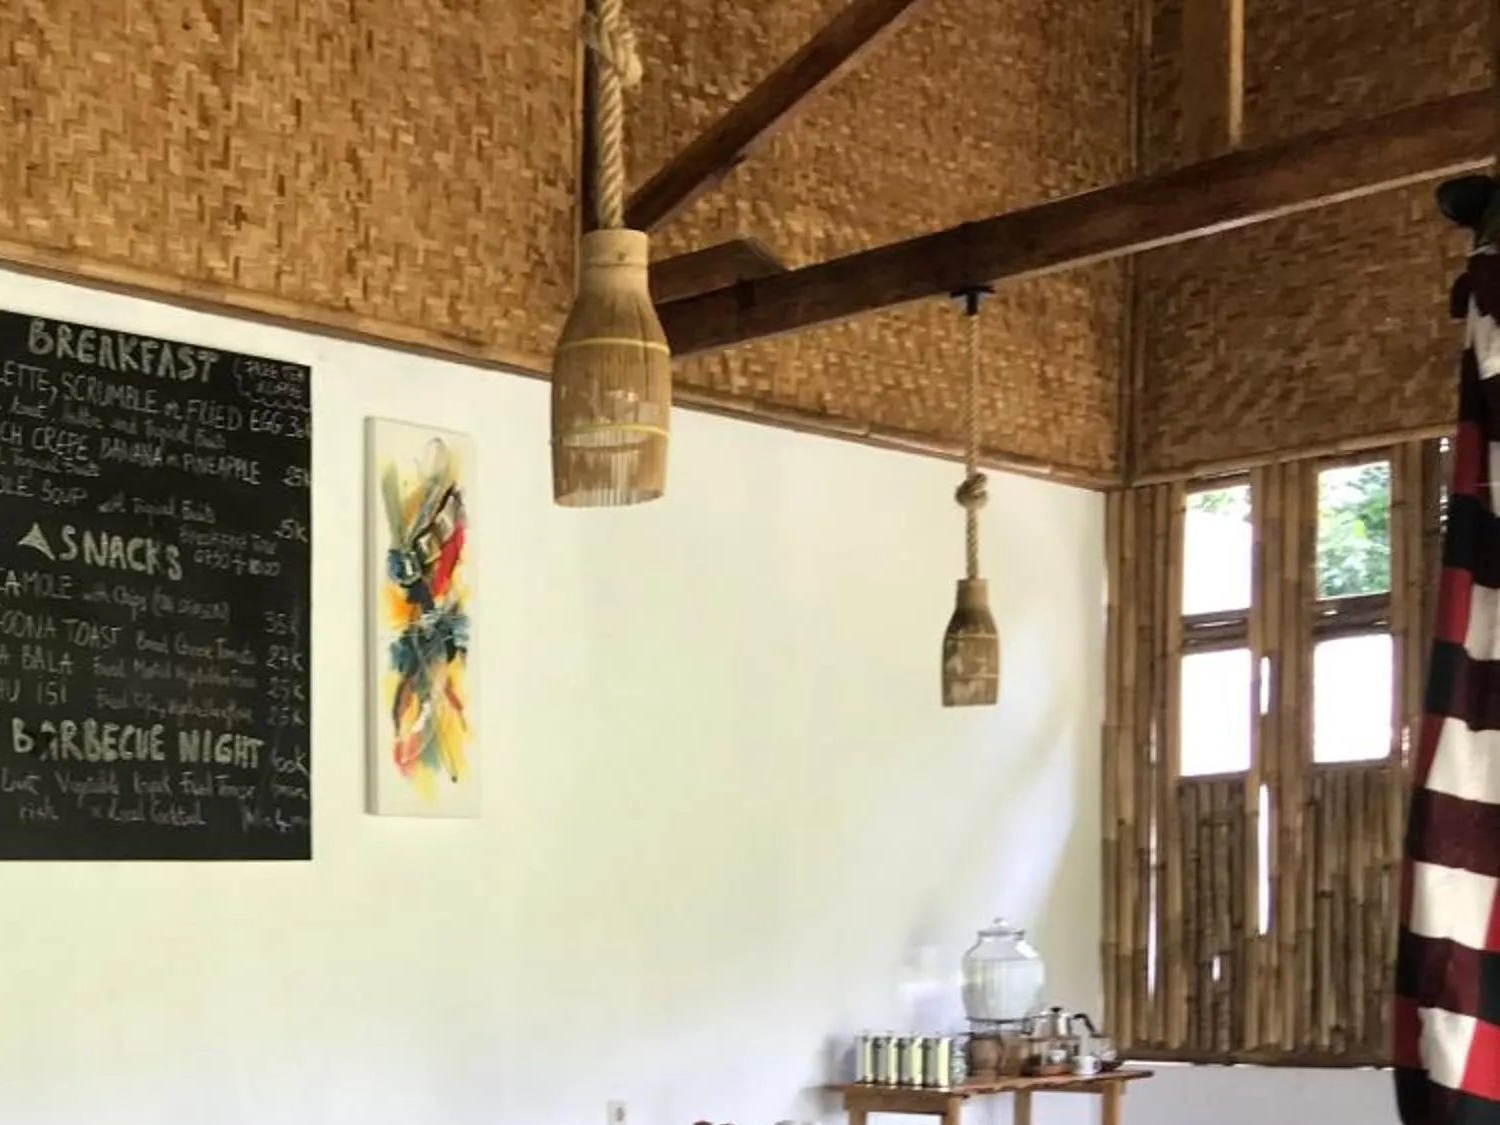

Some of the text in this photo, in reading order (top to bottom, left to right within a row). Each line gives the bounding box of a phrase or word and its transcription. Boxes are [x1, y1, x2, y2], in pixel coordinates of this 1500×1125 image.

[28, 317, 220, 384] BREAKFAST
[250, 408, 285, 437] EGG
[59, 524, 184, 581] SNACKS
[60, 617, 124, 650] TOAST
[21, 643, 76, 678] BALA
[177, 727, 268, 771] NIGHT
